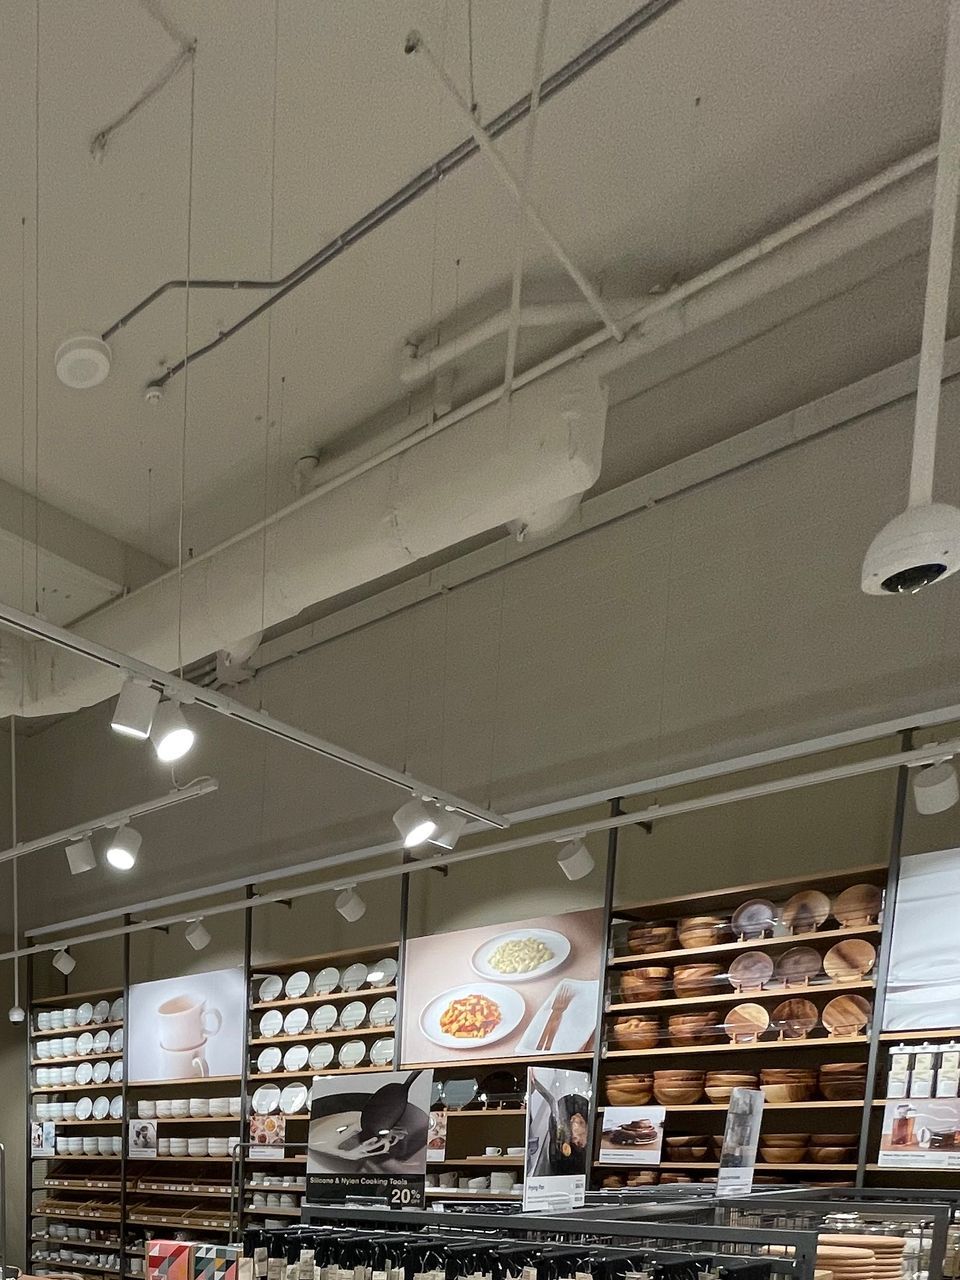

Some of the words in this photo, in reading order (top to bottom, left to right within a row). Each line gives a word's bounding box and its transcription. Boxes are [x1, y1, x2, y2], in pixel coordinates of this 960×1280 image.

[310, 1176, 334, 1184] Silicone
[341, 1177, 360, 1186] Nylon
[360, 1177, 388, 1186] Cooking
[389, 1177, 408, 1186] Tools
